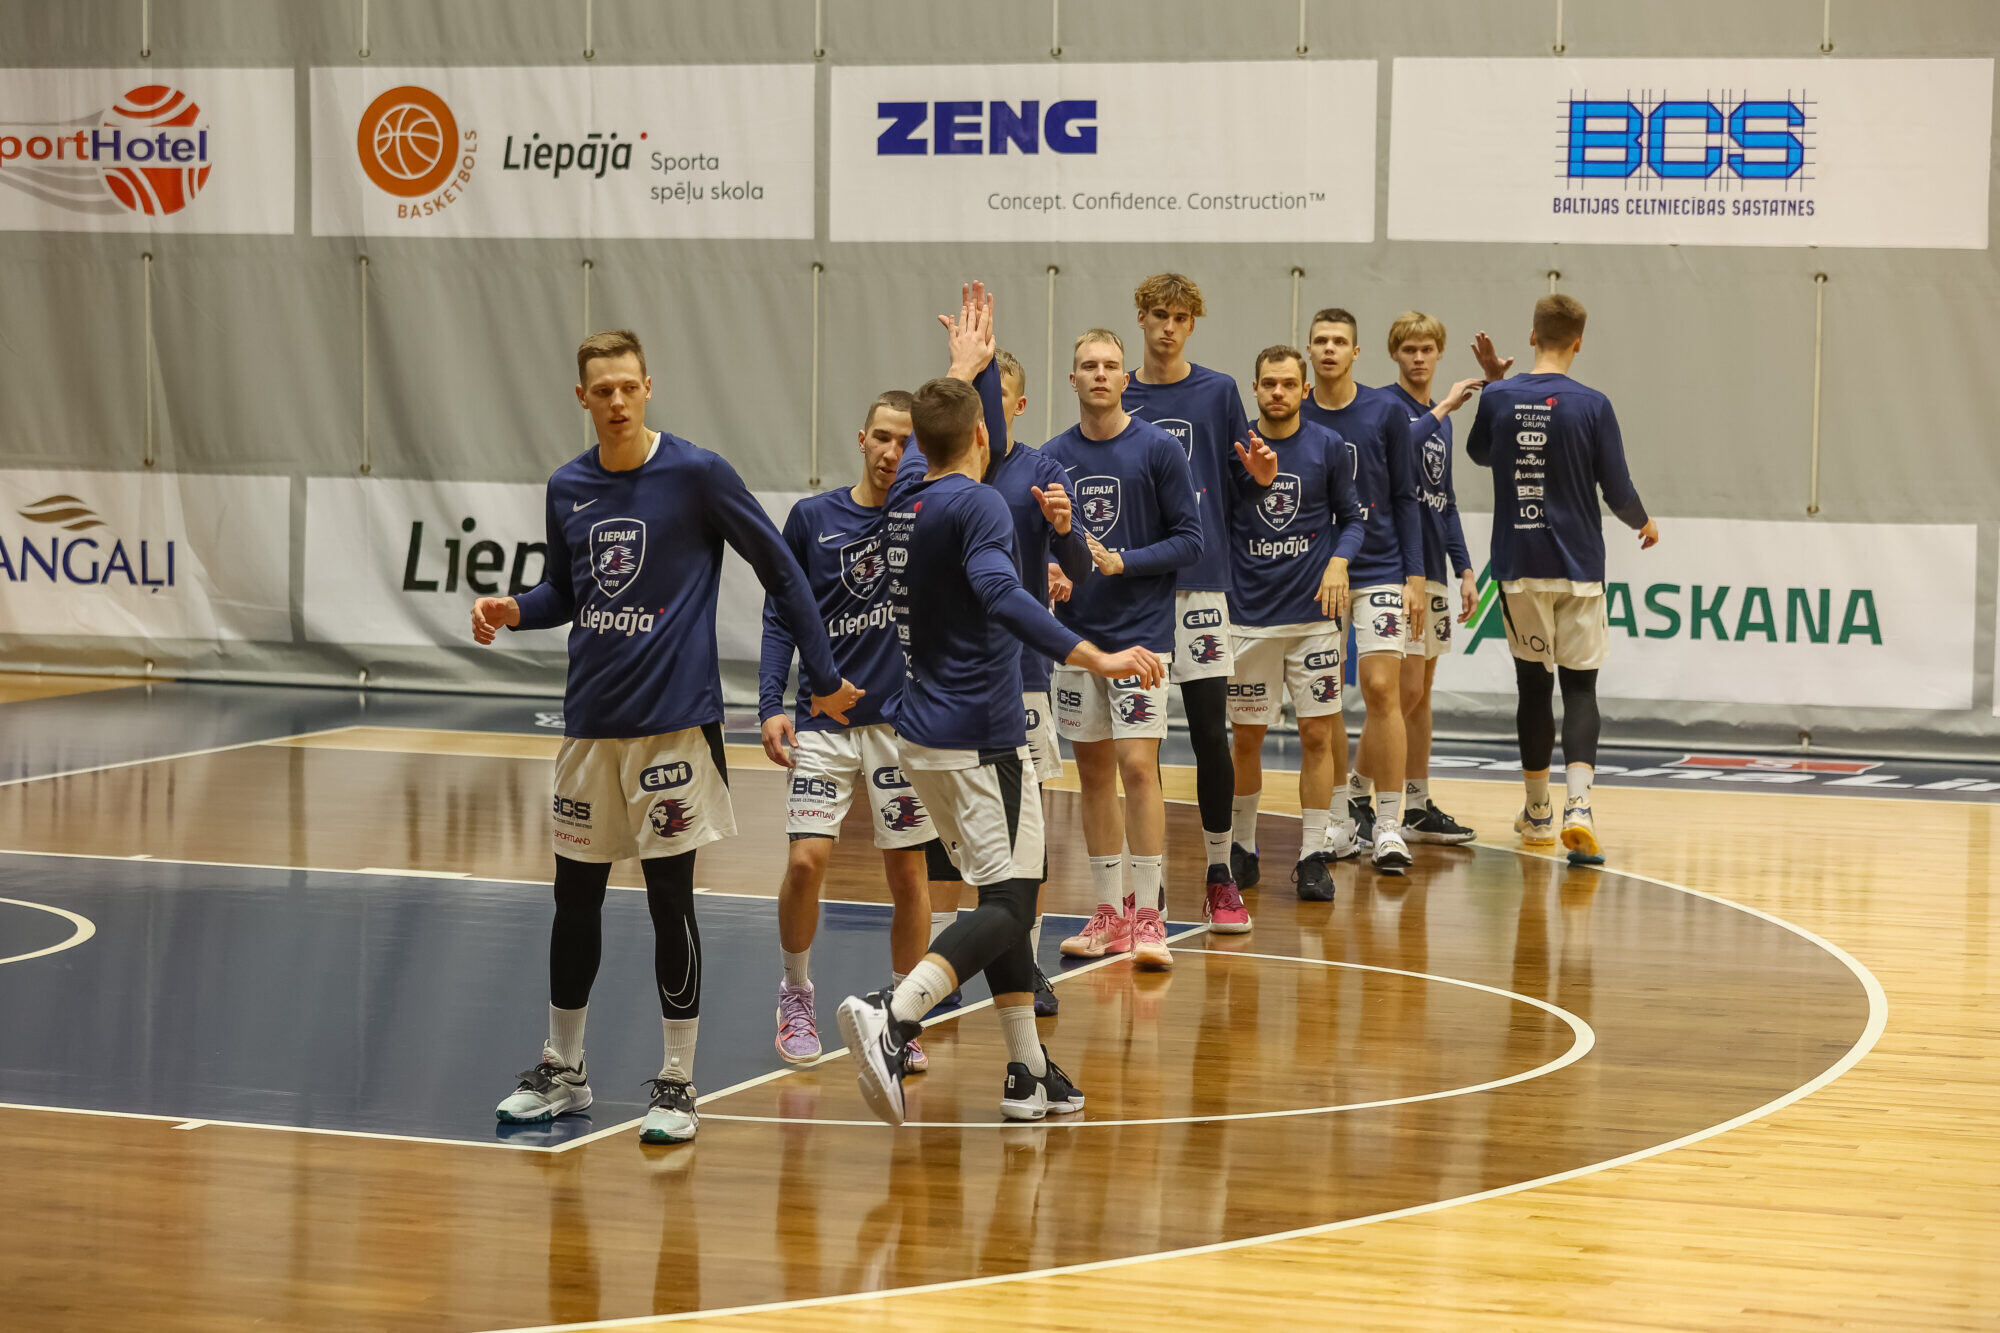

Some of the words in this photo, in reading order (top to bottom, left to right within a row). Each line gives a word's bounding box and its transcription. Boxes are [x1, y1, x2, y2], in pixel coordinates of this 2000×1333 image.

[877, 100, 1097, 155] ZENG
[1567, 100, 1805, 178] BCS
[503, 133, 633, 178] Liepāja
[650, 152, 720, 173] Sporta
[397, 129, 478, 219] BASKETBOLS
[650, 182, 704, 204] spēļu
[711, 181, 764, 200] skola
[987, 193, 1066, 213] Concept.
[1073, 193, 1182, 210] Confidence.
[1552, 197, 1619, 214] BALTIJAS
[1732, 199, 1815, 216] SASTATNES
[1249, 536, 1309, 560] Liepāja
[580, 603, 654, 637] Liepāja
[1227, 683, 1266, 697] BCS
[792, 777, 838, 799] BCS
